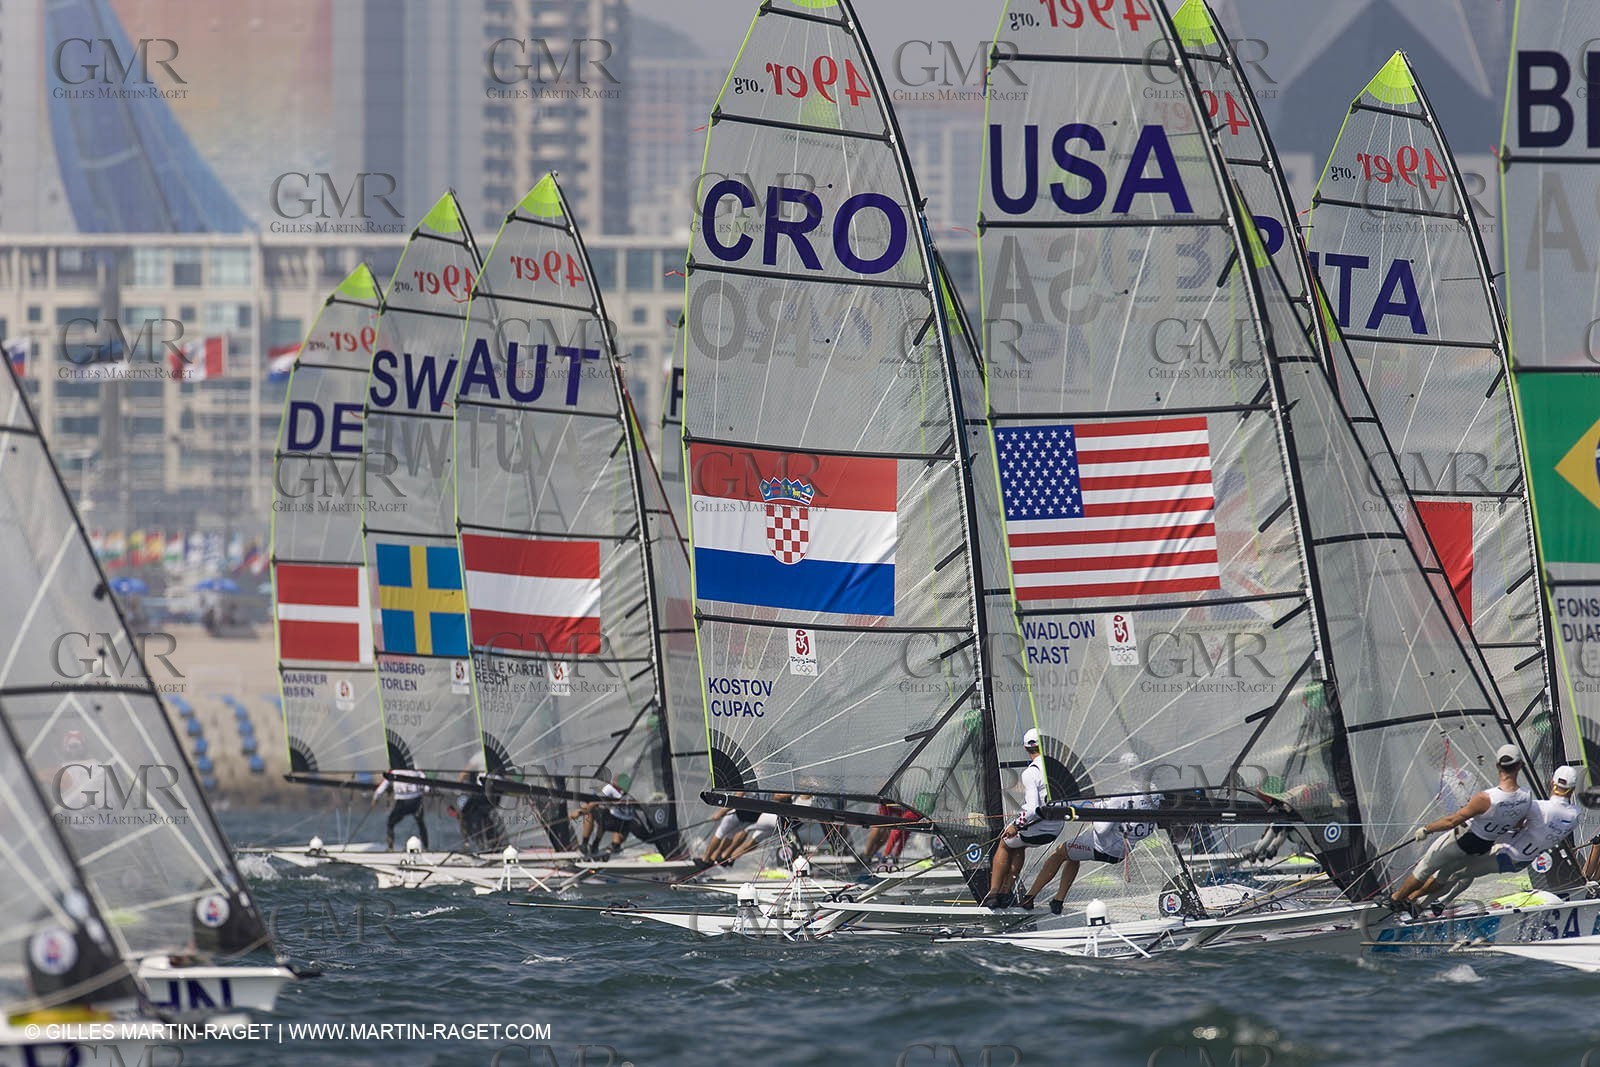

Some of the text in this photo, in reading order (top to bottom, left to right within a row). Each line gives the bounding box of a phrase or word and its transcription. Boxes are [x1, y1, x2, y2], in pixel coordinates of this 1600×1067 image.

[989, 123, 1194, 215] USA
[702, 179, 908, 274] CRO
[1308, 251, 1428, 335] TA
[369, 349, 458, 413] SW
[459, 338, 601, 407] AUT
[287, 402, 364, 453] DE
[1021, 619, 1095, 640] WADLOW
[1027, 646, 1070, 664] RAST
[378, 662, 425, 675] LINDBERG
[475, 660, 544, 677] DELLE KARTH
[475, 671, 509, 686] RESCH
[283, 673, 327, 685] WARRER
[381, 677, 417, 691] TORLEN
[708, 677, 773, 697] KOSTOV
[711, 700, 765, 718] CUPAC
